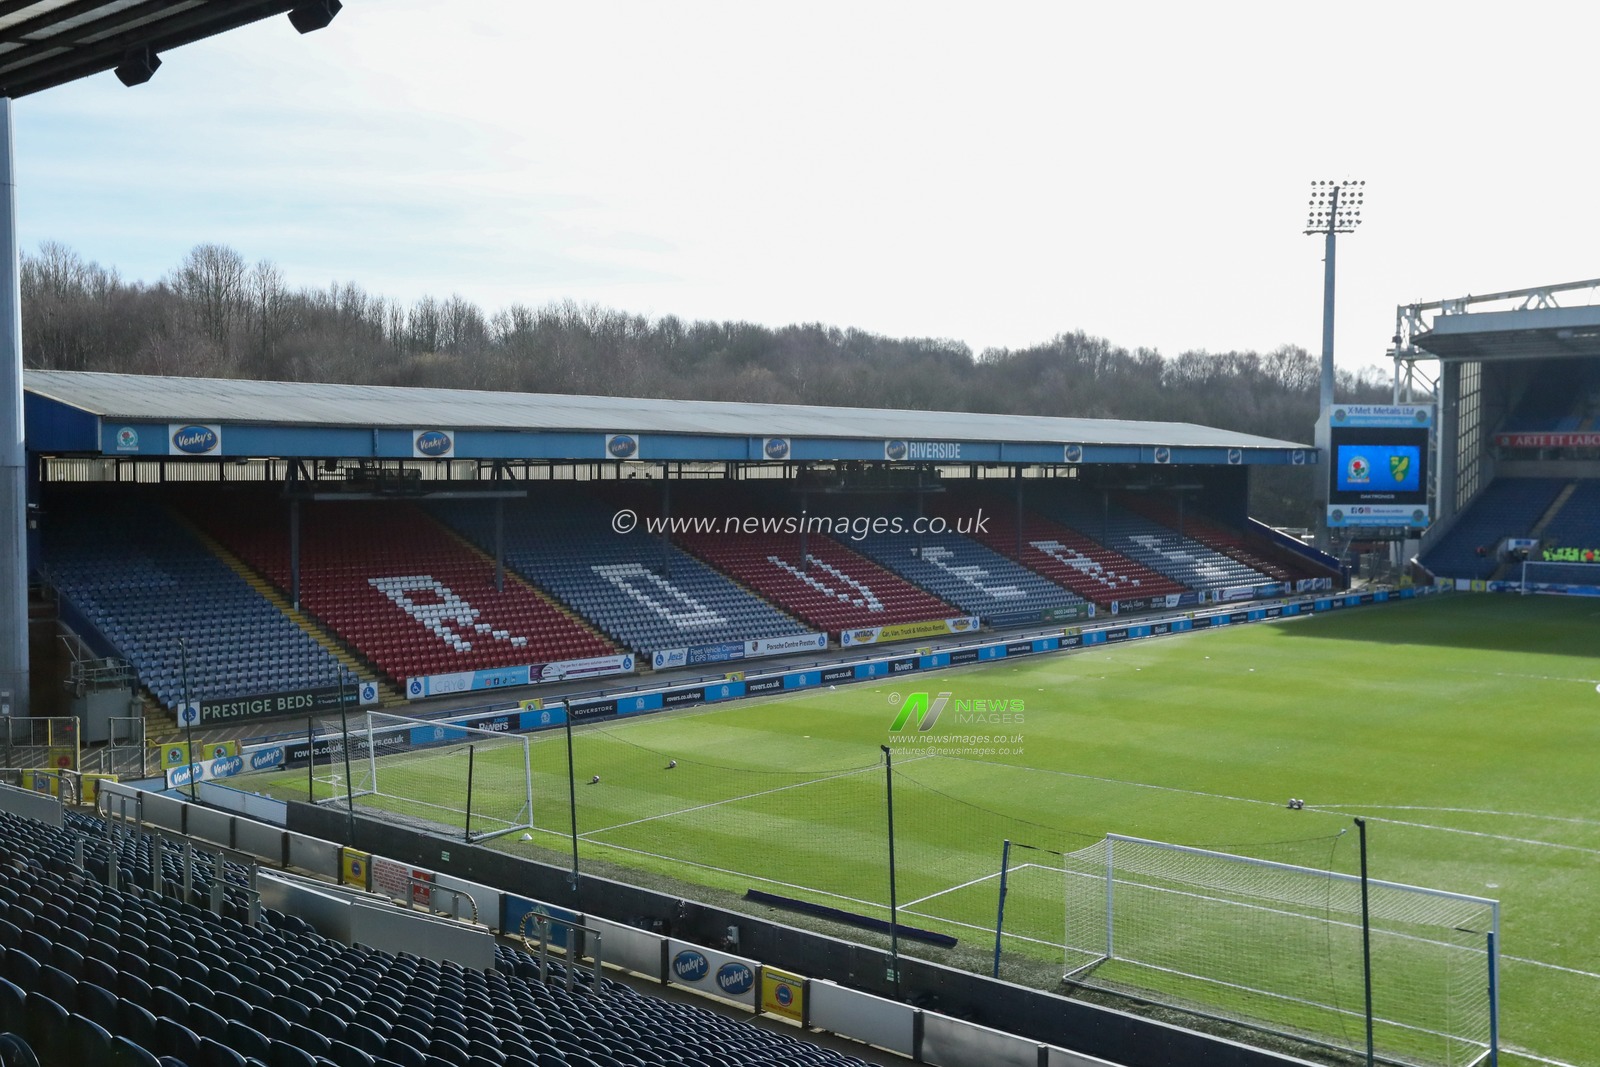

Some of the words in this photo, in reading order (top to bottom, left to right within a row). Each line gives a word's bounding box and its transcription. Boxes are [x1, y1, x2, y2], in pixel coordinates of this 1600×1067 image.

[178, 430, 212, 447] Venky's
[420, 437, 447, 450] Venky's
[1516, 435, 1544, 445] ARTE
[1550, 435, 1565, 445] ET
[910, 442, 960, 458] RIVERSIDE
[854, 629, 874, 638] INTACK
[901, 628, 912, 636] Truck
[704, 645, 721, 654] Vehicle
[722, 643, 744, 652] Cameras
[766, 642, 784, 650] Porsche
[785, 640, 798, 649] Centre
[695, 654, 706, 662] GPS
[707, 652, 728, 661] Tracking
[824, 670, 852, 680] rovers.co.uk
[750, 681, 780, 691] rovers.co.uk
[666, 692, 701, 702] rovers.co.uk/app
[202, 699, 272, 720] PRESTIGE
[277, 694, 314, 711] BEDS
[575, 705, 613, 715] ROVERSTORE
[254, 749, 280, 767] Venky's
[214, 758, 240, 775] Venky's
[676, 956, 704, 975] Venky's
[720, 968, 749, 988] Venky's
